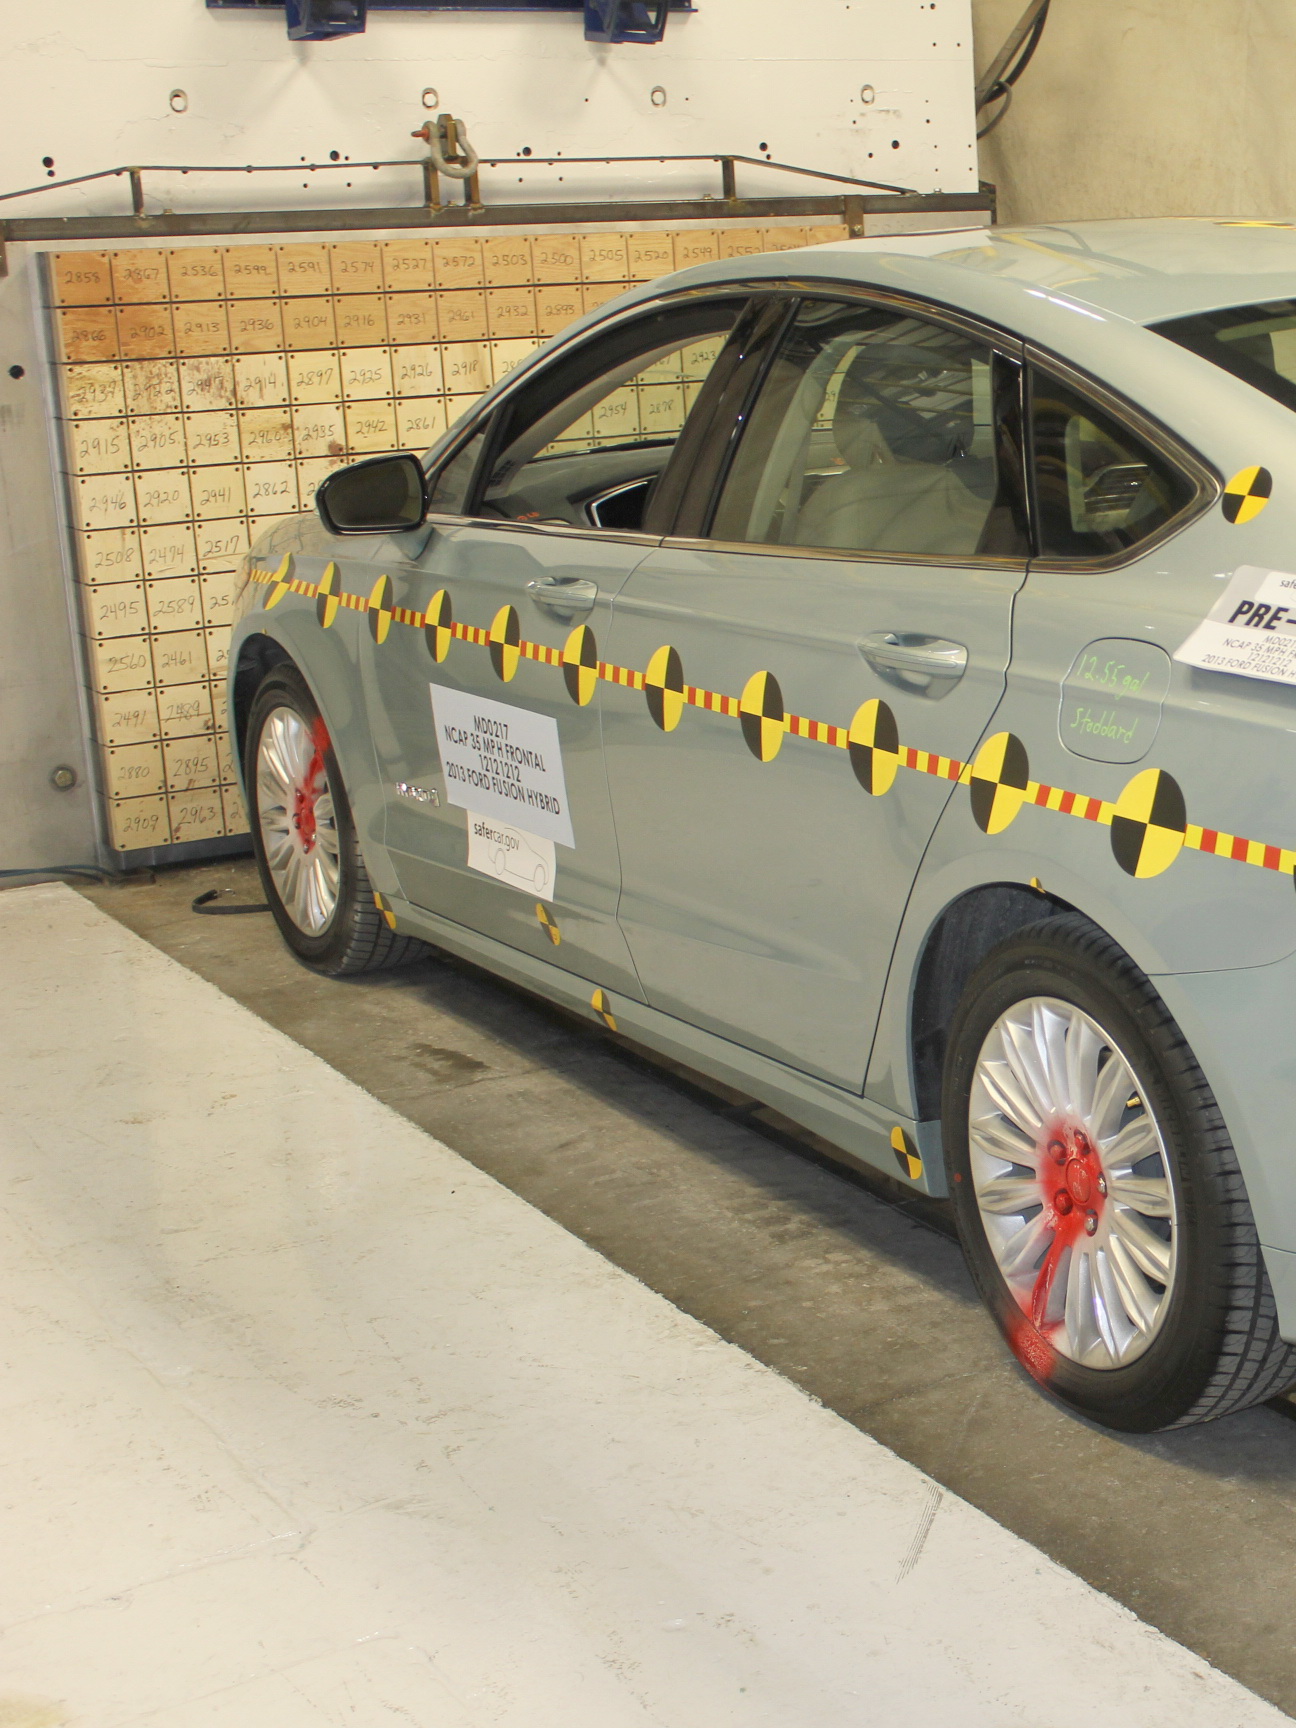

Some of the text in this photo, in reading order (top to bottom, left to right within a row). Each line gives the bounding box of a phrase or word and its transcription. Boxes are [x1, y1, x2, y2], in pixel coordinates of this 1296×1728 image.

[442, 255, 476, 268] 2572
[492, 254, 528, 266] 2503
[540, 252, 574, 265] 2500
[589, 249, 624, 261] 2505
[634, 250, 669, 263] 2520
[682, 246, 713, 259] 2549
[181, 265, 218, 277] 2536
[287, 261, 323, 274] 2591
[340, 261, 375, 273] 2574
[392, 258, 427, 270] 2527
[344, 314, 375, 327] 2916
[397, 313, 426, 325] 2931
[497, 305, 529, 318] 2932
[130, 325, 167, 339] 2902
[183, 322, 220, 334] 2913
[240, 318, 275, 333] 2936
[294, 316, 328, 330] 2904
[350, 368, 383, 384] 2925
[401, 363, 433, 380] 2926
[451, 359, 479, 376] 2918
[243, 371, 277, 392] 2914
[296, 368, 334, 387] 2897
[598, 401, 627, 419] 2954
[301, 424, 336, 441] 2935
[355, 420, 388, 436] 2942
[406, 416, 436, 432] 2861
[80, 435, 121, 458] 2915
[137, 430, 179, 452] 2905
[193, 432, 231, 450] 2953
[248, 430, 282, 446] 2960
[143, 489, 180, 508] 2920
[200, 486, 231, 506] 2941
[252, 480, 291, 499] 2862
[88, 491, 127, 513] 2946
[148, 543, 185, 566] 2474
[202, 534, 240, 558] 2517
[94, 547, 135, 569] 2508
[99, 600, 140, 620] 2495
[152, 594, 196, 617] 2589
[1222, 637, 1252, 651] NCAP
[1250, 642, 1263, 653] 35
[1263, 644, 1287, 657] MPH
[107, 653, 147, 674] 2560
[161, 650, 193, 669] 2461
[1202, 654, 1226, 666] 2013
[1225, 658, 1252, 671] FORD
[1251, 662, 1289, 677] FUSION
[1077, 654, 1151, 700] 12.55 gal
[112, 709, 147, 728] 2491
[473, 715, 509, 741] MD0217
[1070, 707, 1139, 744] Stoddard
[444, 724, 546, 773] NCAP 35 MPH FRONTAL
[117, 765, 150, 781] 2880
[173, 756, 211, 777] 2895
[478, 753, 522, 783] 12121212
[446, 761, 561, 816] 2013 FORD FUSION HYBRID
[123, 814, 159, 833] 2909
[178, 806, 217, 826] 2963
[473, 821, 520, 852] safercar.gov
